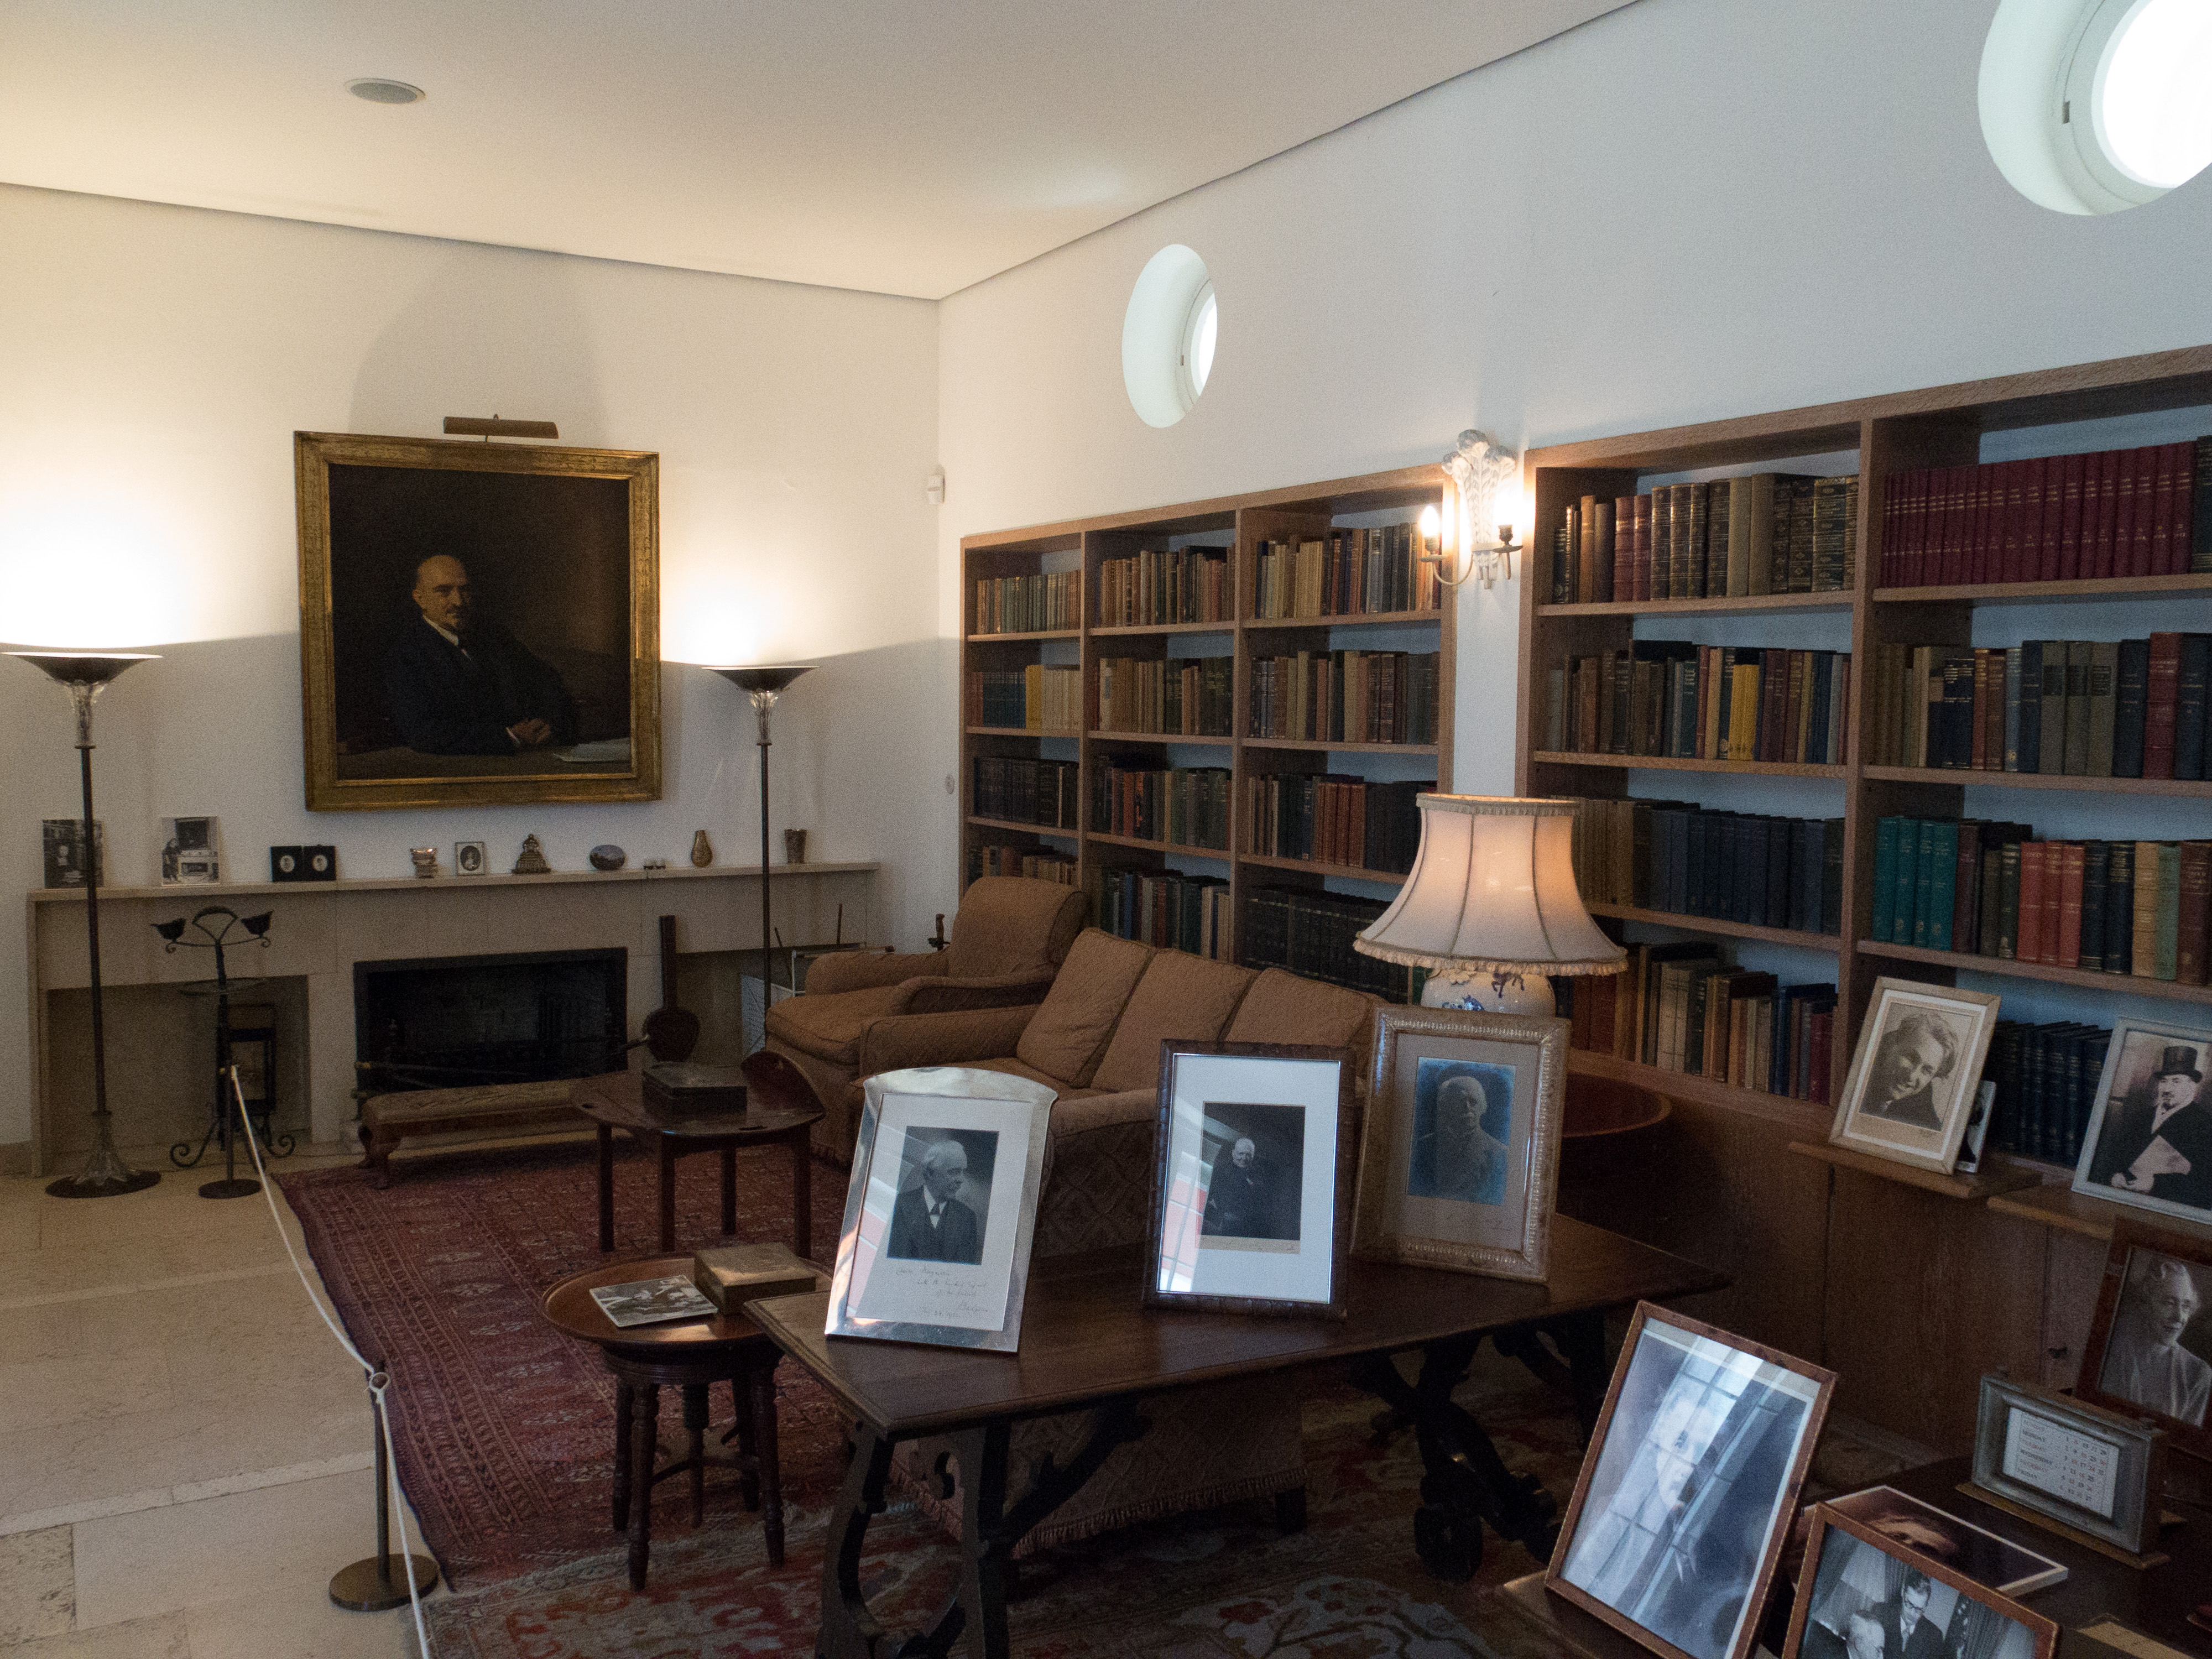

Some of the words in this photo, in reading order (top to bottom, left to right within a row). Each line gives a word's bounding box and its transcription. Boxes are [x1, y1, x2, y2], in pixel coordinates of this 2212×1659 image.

[2022, 1429, 2045, 1443] MONDAY
[2020, 1448, 2053, 1466] WEDNESDAY
[2017, 1467, 2037, 1480] FRIDAY
